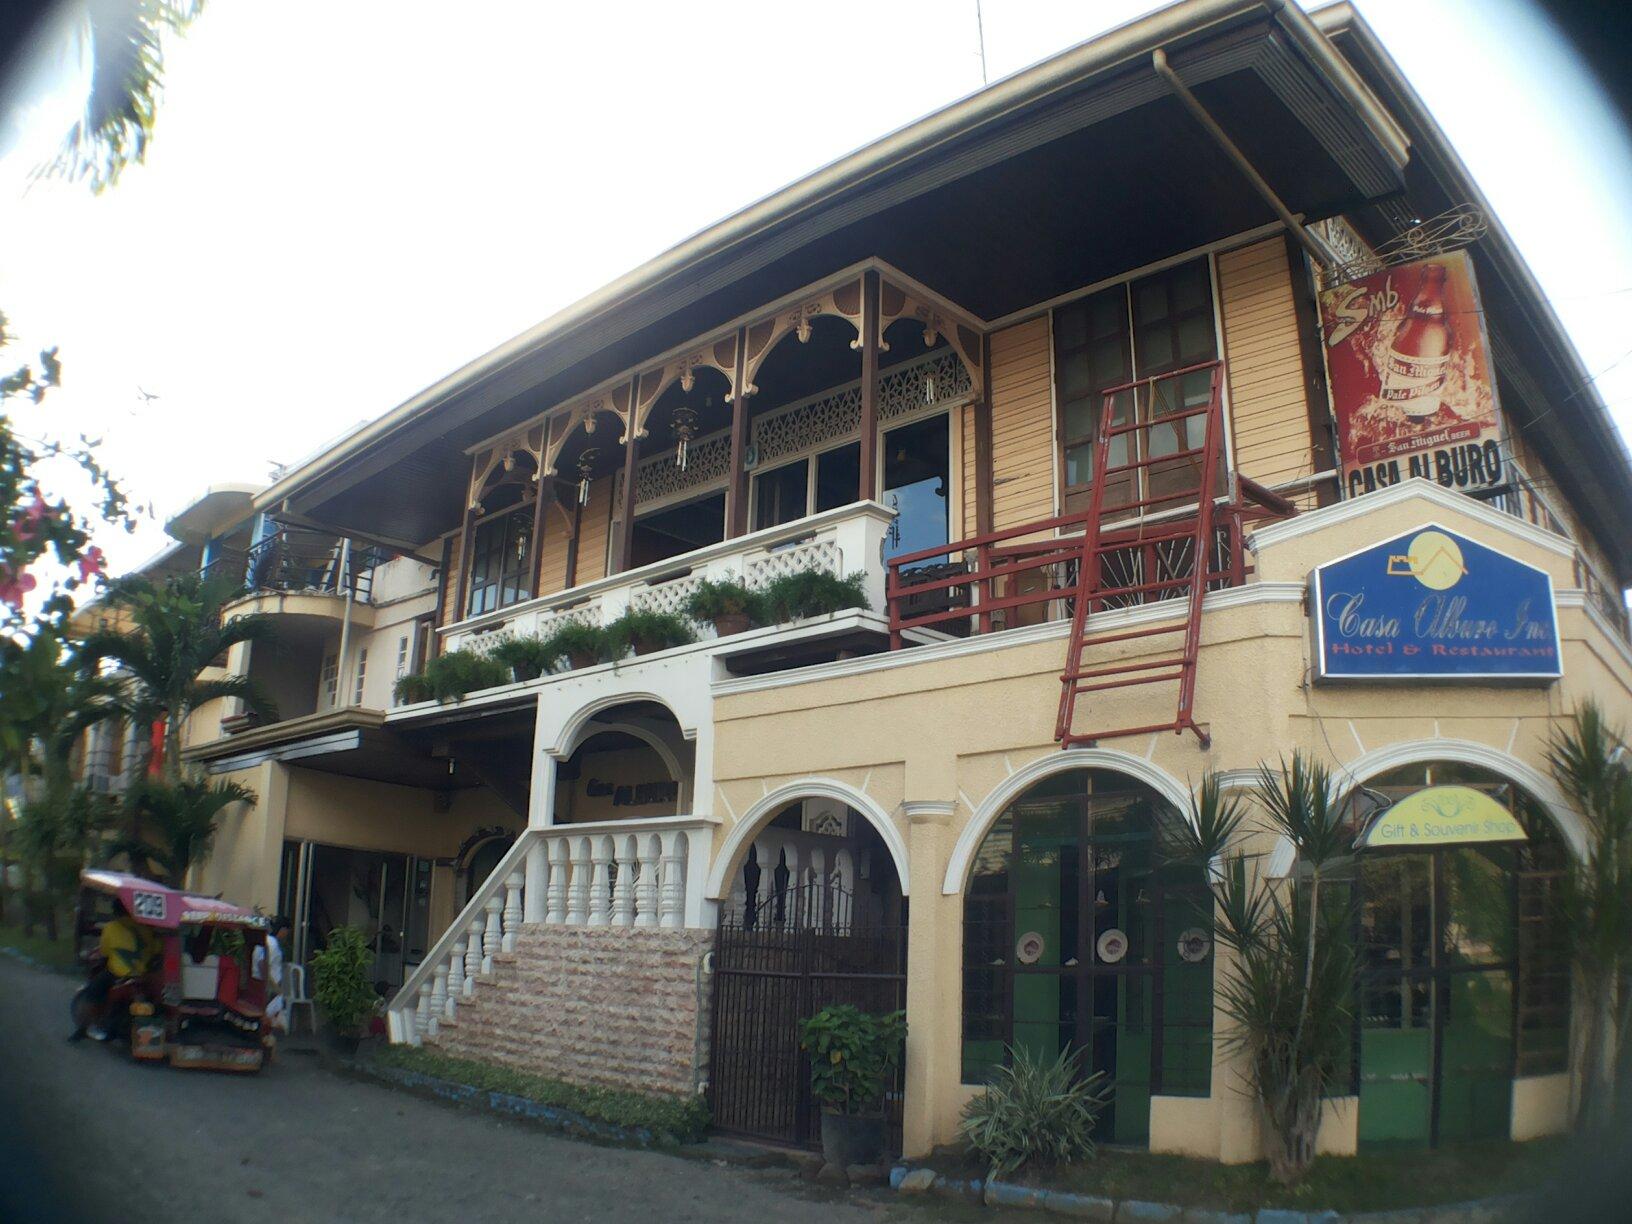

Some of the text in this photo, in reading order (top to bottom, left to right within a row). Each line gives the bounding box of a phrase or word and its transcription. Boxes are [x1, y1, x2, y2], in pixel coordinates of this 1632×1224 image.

[1388, 441, 1410, 453] San
[1411, 429, 1450, 449] Miguel
[1348, 460, 1401, 499] CASA
[1326, 592, 1400, 640] Casa
[1414, 595, 1499, 640] Alburo
[1331, 643, 1555, 657] Hotel & Restaurant
[1381, 820, 1516, 838] Gift & Souvenir Shop
